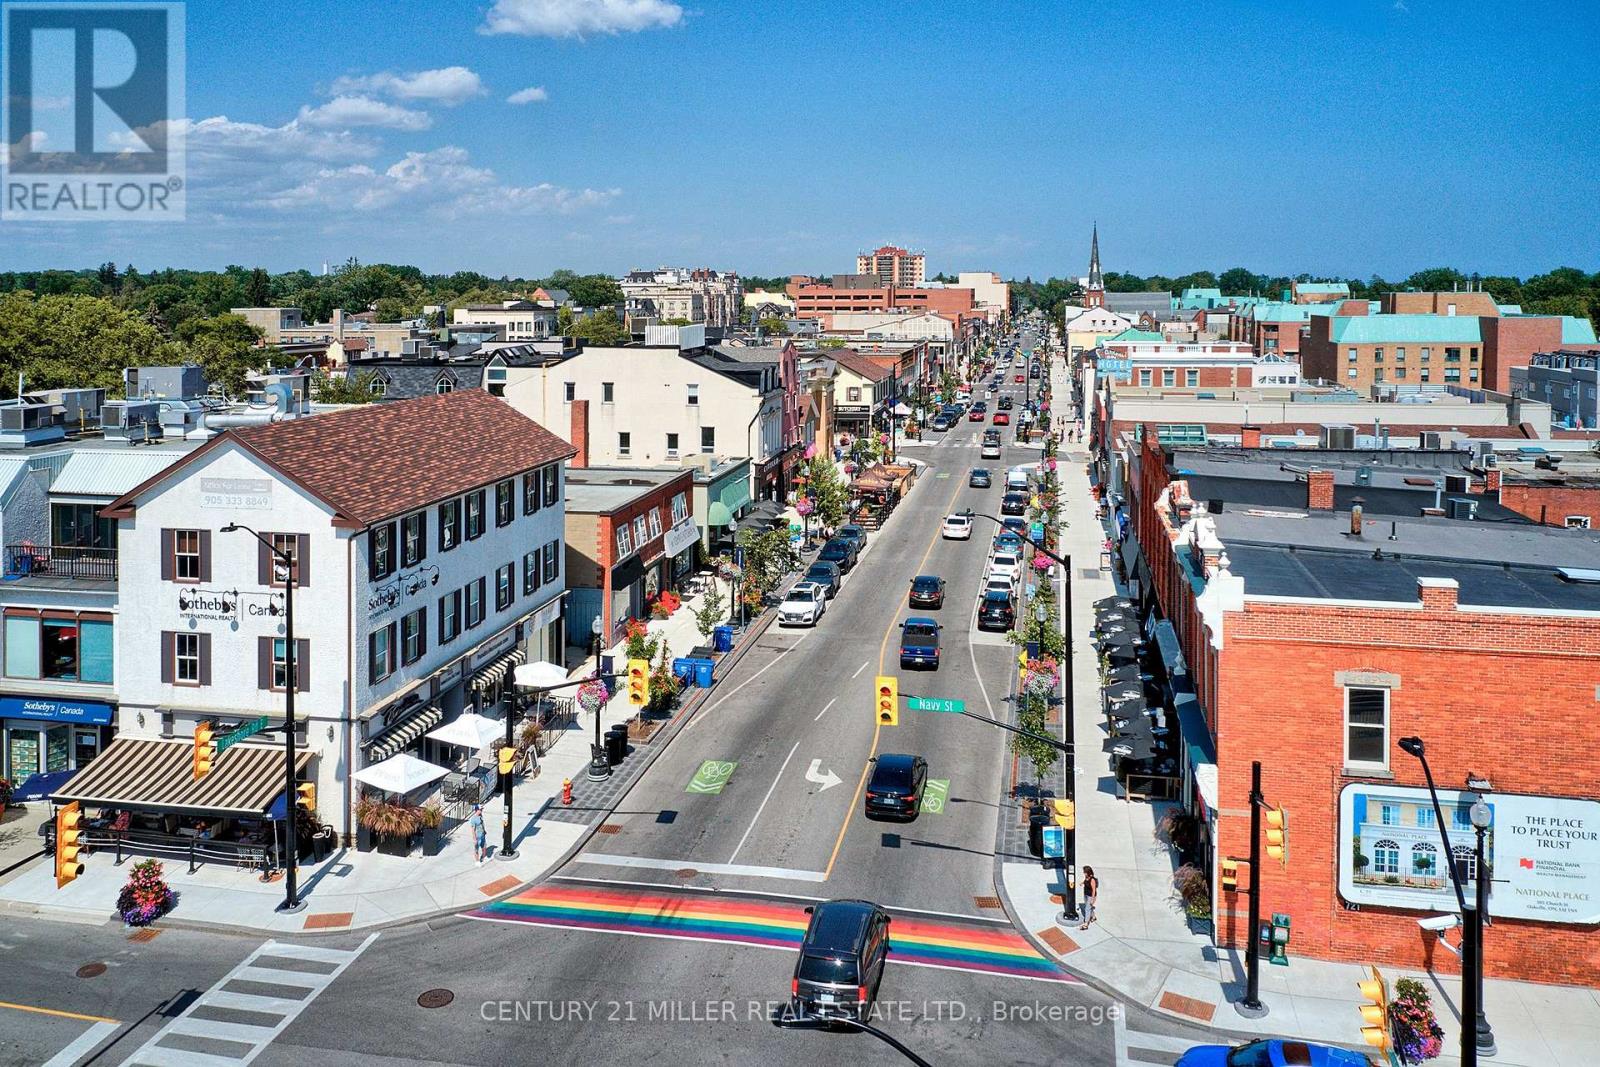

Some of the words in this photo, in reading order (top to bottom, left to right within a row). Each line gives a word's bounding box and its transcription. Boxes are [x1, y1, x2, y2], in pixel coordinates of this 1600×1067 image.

[1097, 360, 1132, 370] HOTEL
[204, 495, 223, 505] 905
[225, 496, 242, 506] 333
[24, 701, 56, 712] Sotheby's
[60, 705, 84, 716] Canada
[920, 699, 940, 711] Navy
[944, 700, 953, 712] St
[1525, 815, 1547, 826] THE
[1550, 817, 1583, 829] PLACE
[1511, 825, 1527, 835] TO
[1530, 827, 1563, 838] PLACE
[1565, 830, 1597, 841] YOUR
[1537, 838, 1571, 850] TRUST
[1515, 888, 1561, 899] NATIONAL
[1563, 892, 1590, 901] PLACE
